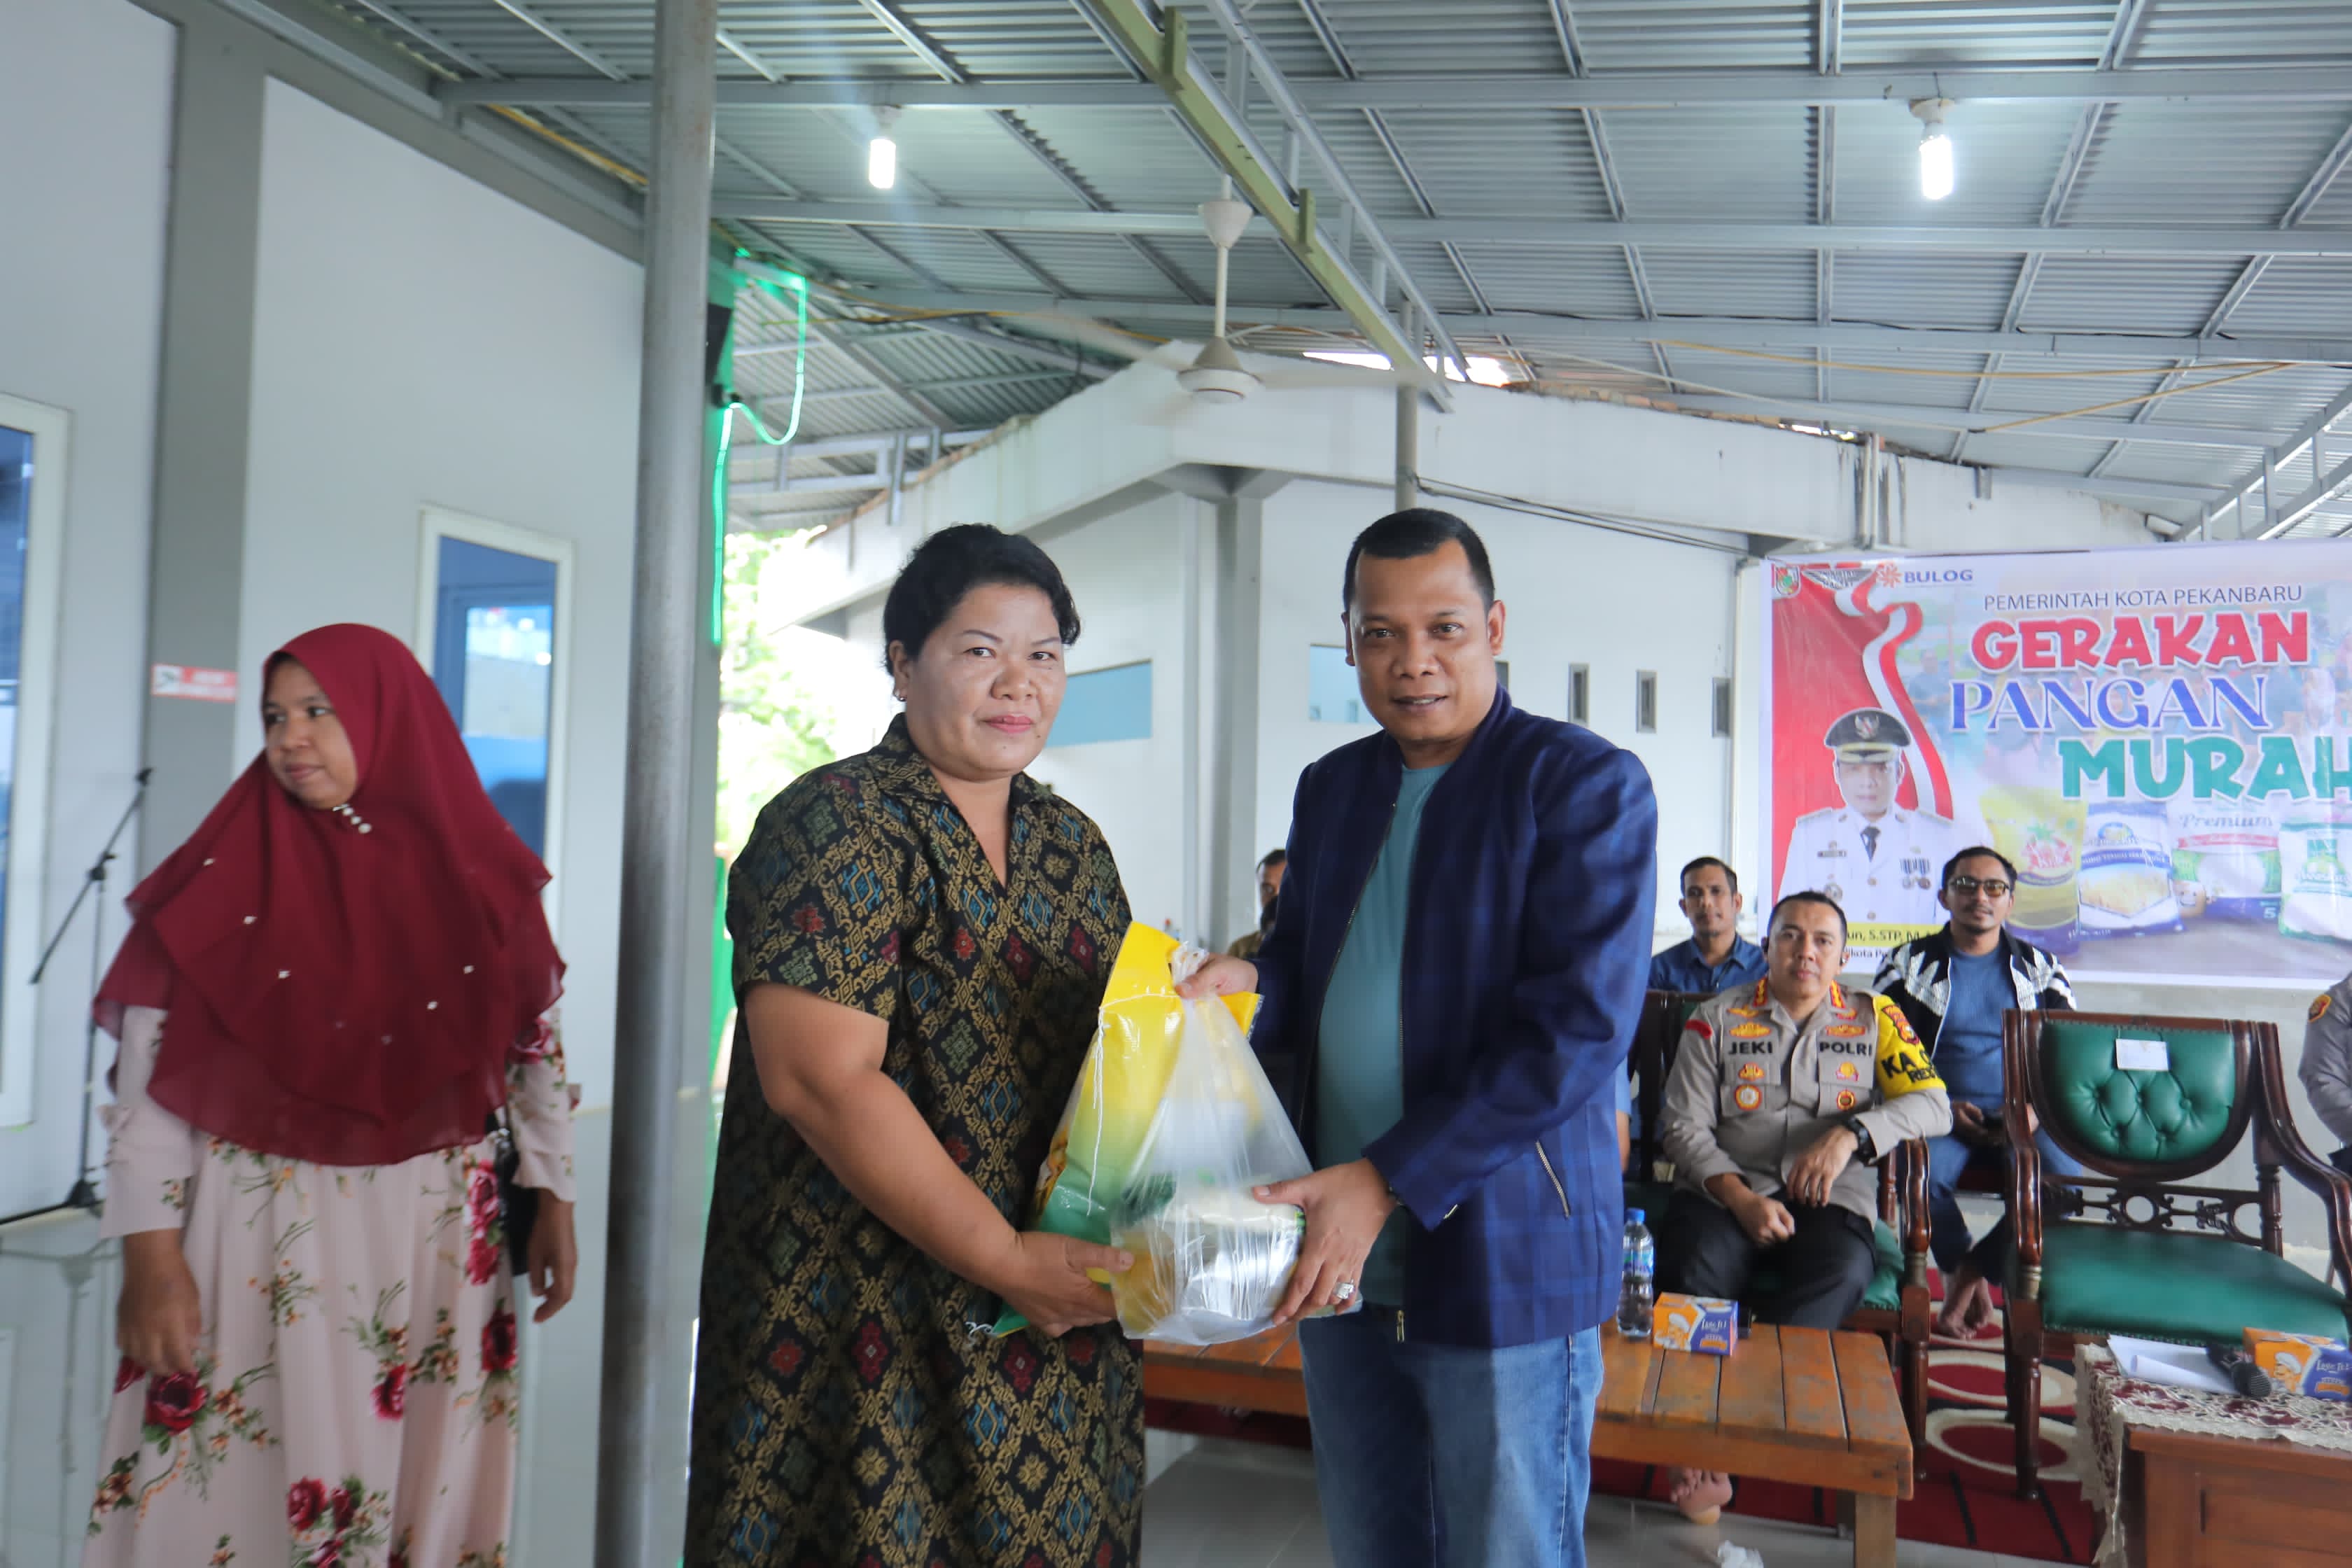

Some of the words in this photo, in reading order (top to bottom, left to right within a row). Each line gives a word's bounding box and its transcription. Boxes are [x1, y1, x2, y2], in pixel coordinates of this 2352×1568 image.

[1904, 569, 1973, 582] BULOG
[1984, 592, 2108, 611] PEMERINTAH
[2115, 590, 2168, 606] KOTA
[2174, 584, 2303, 605] PEKANBARU
[1971, 611, 2308, 670] GERAKAN
[1951, 677, 2271, 730] PANGAN
[1728, 1041, 1773, 1056] JEKI
[1819, 1041, 1873, 1056] POLRI
